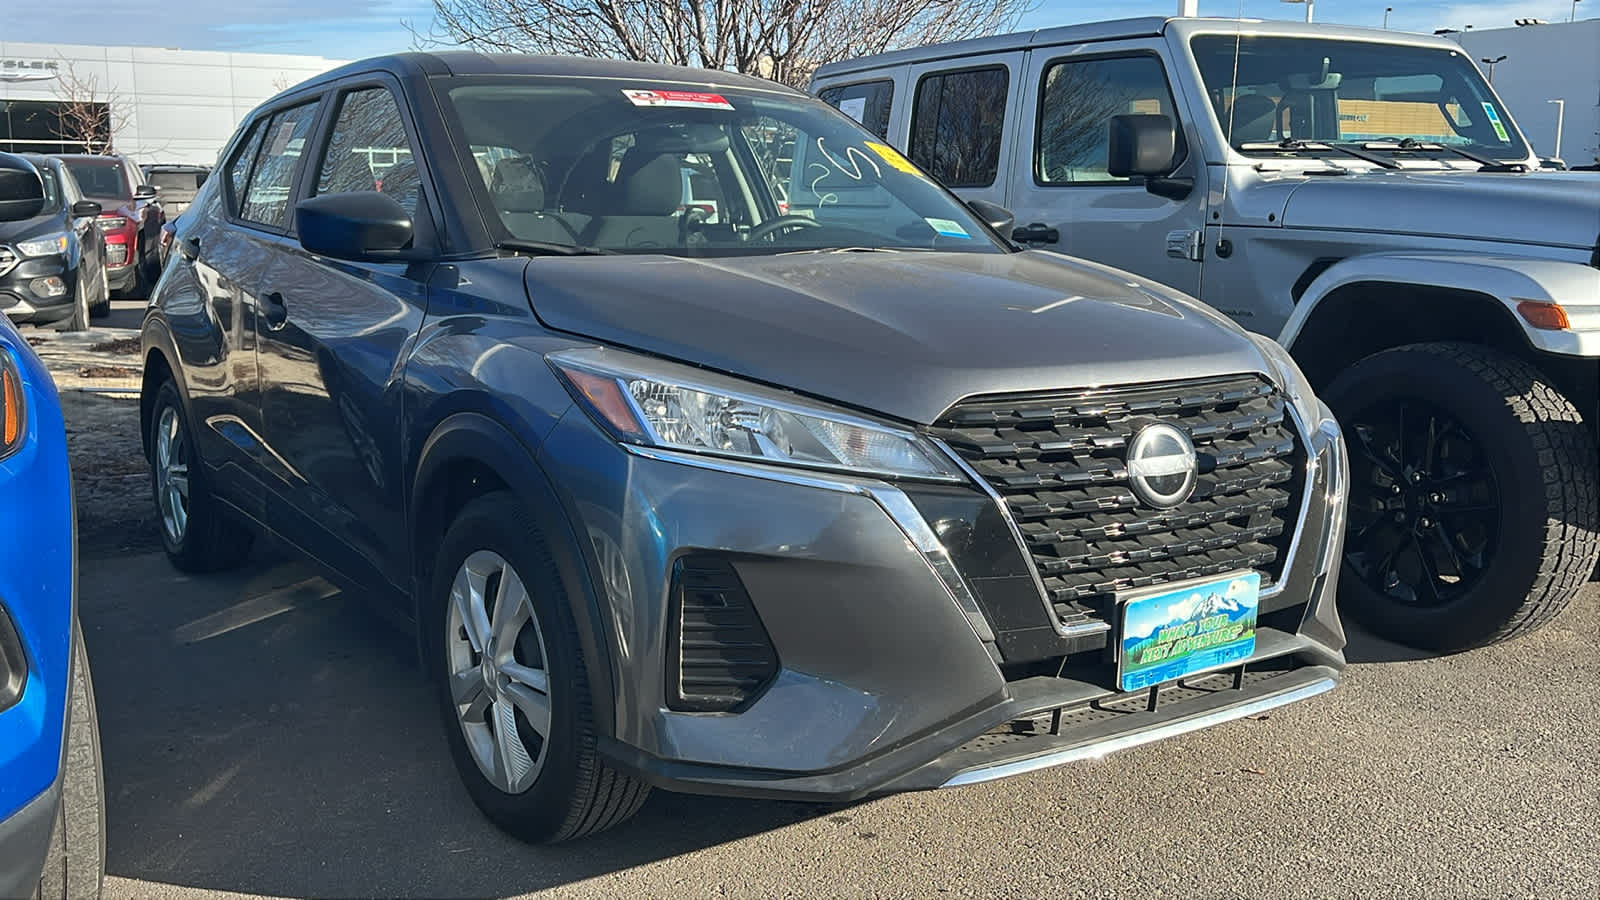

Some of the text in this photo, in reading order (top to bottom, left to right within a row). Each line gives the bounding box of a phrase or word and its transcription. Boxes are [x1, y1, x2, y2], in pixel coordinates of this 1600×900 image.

[0, 60, 59, 69] SLER
[1198, 614, 1229, 635] YOUR
[1140, 624, 1243, 664] NEXT ADVENTURE?
